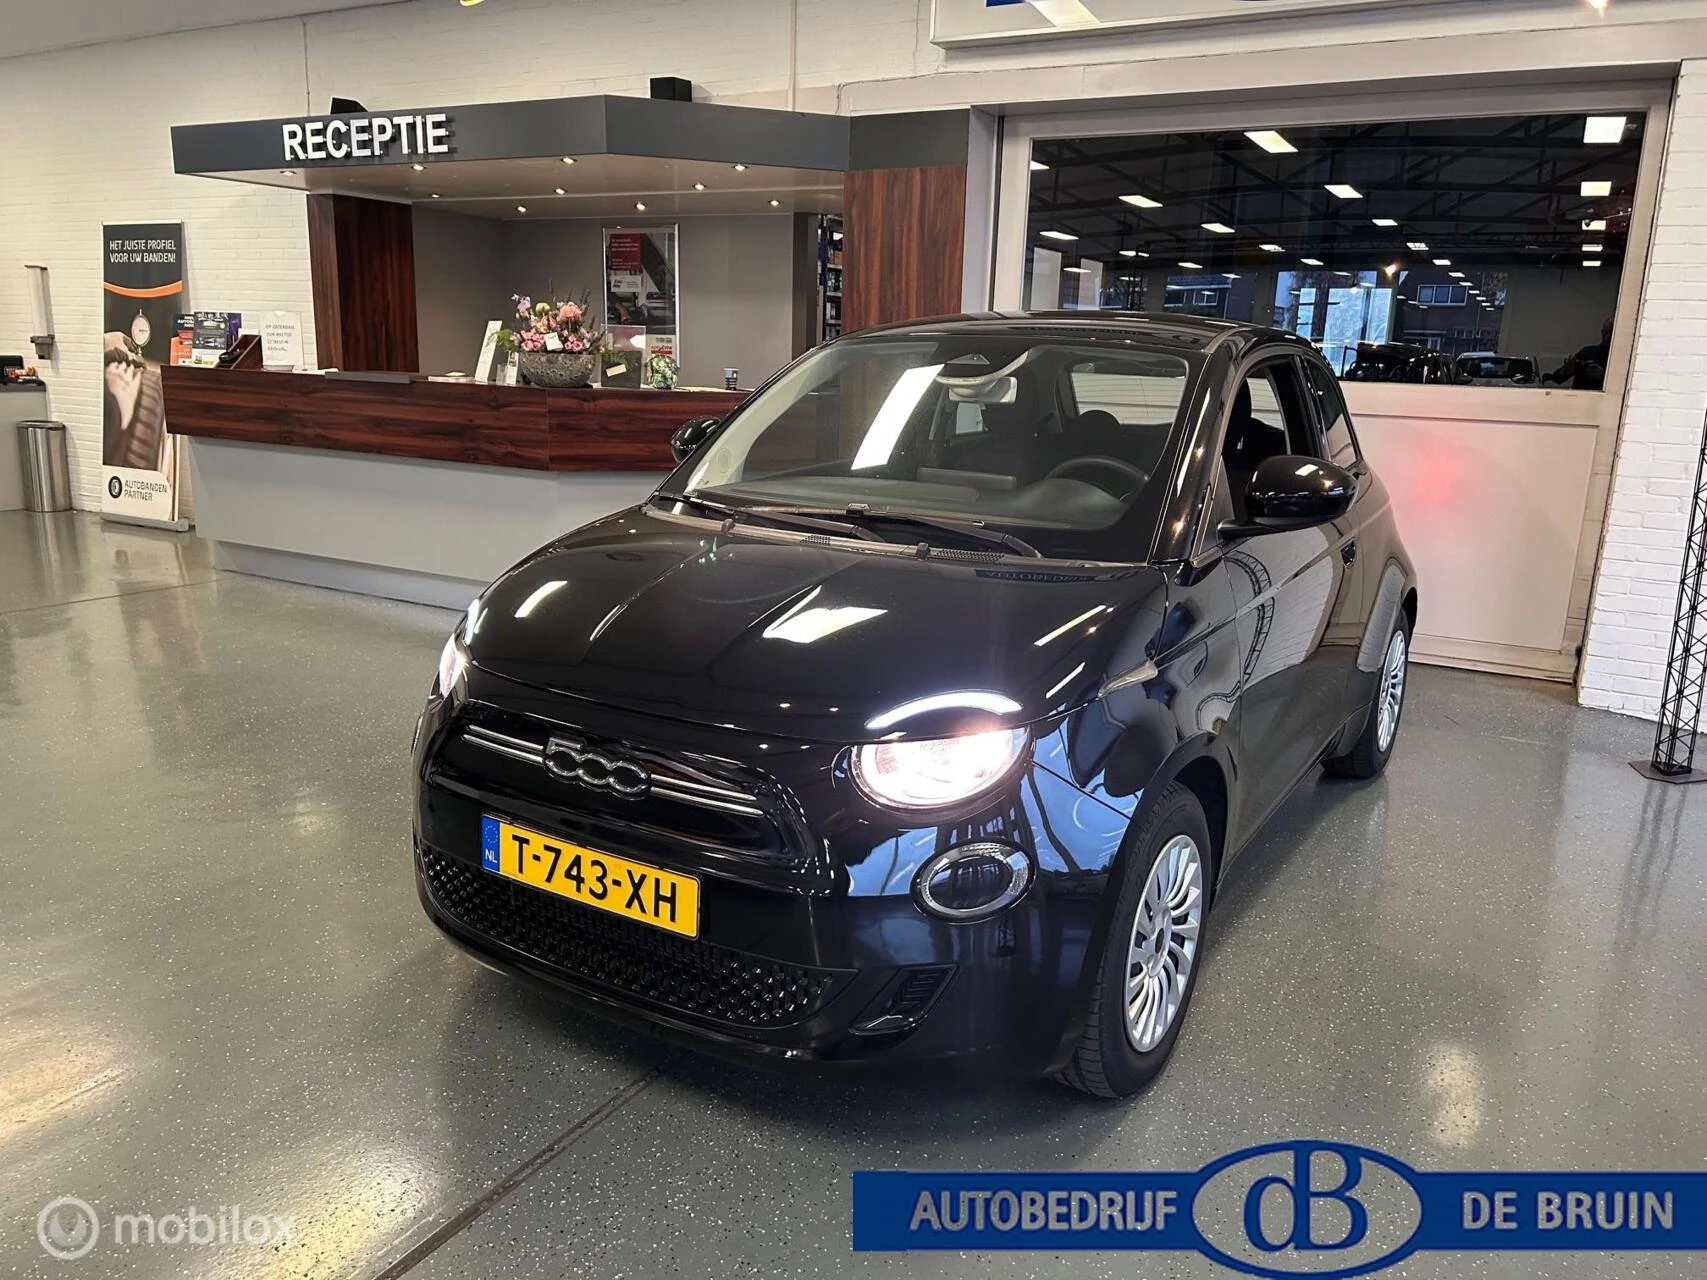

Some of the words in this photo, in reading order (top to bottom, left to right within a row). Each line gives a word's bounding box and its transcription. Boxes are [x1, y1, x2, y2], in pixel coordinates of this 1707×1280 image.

[282, 113, 449, 161] RECEPTIE
[109, 239, 122, 250] HET
[123, 239, 146, 250] JUISTE
[147, 239, 176, 250] PROFIEL
[109, 252, 129, 263] VOOR
[129, 252, 142, 263] UW
[143, 252, 176, 263] BANDEN!
[124, 480, 167, 493] AUTOBANDEN
[124, 489, 153, 501] PARTNER
[545, 735, 652, 800] 500
[484, 848, 498, 864] NL
[511, 833, 677, 923] T-743-XH
